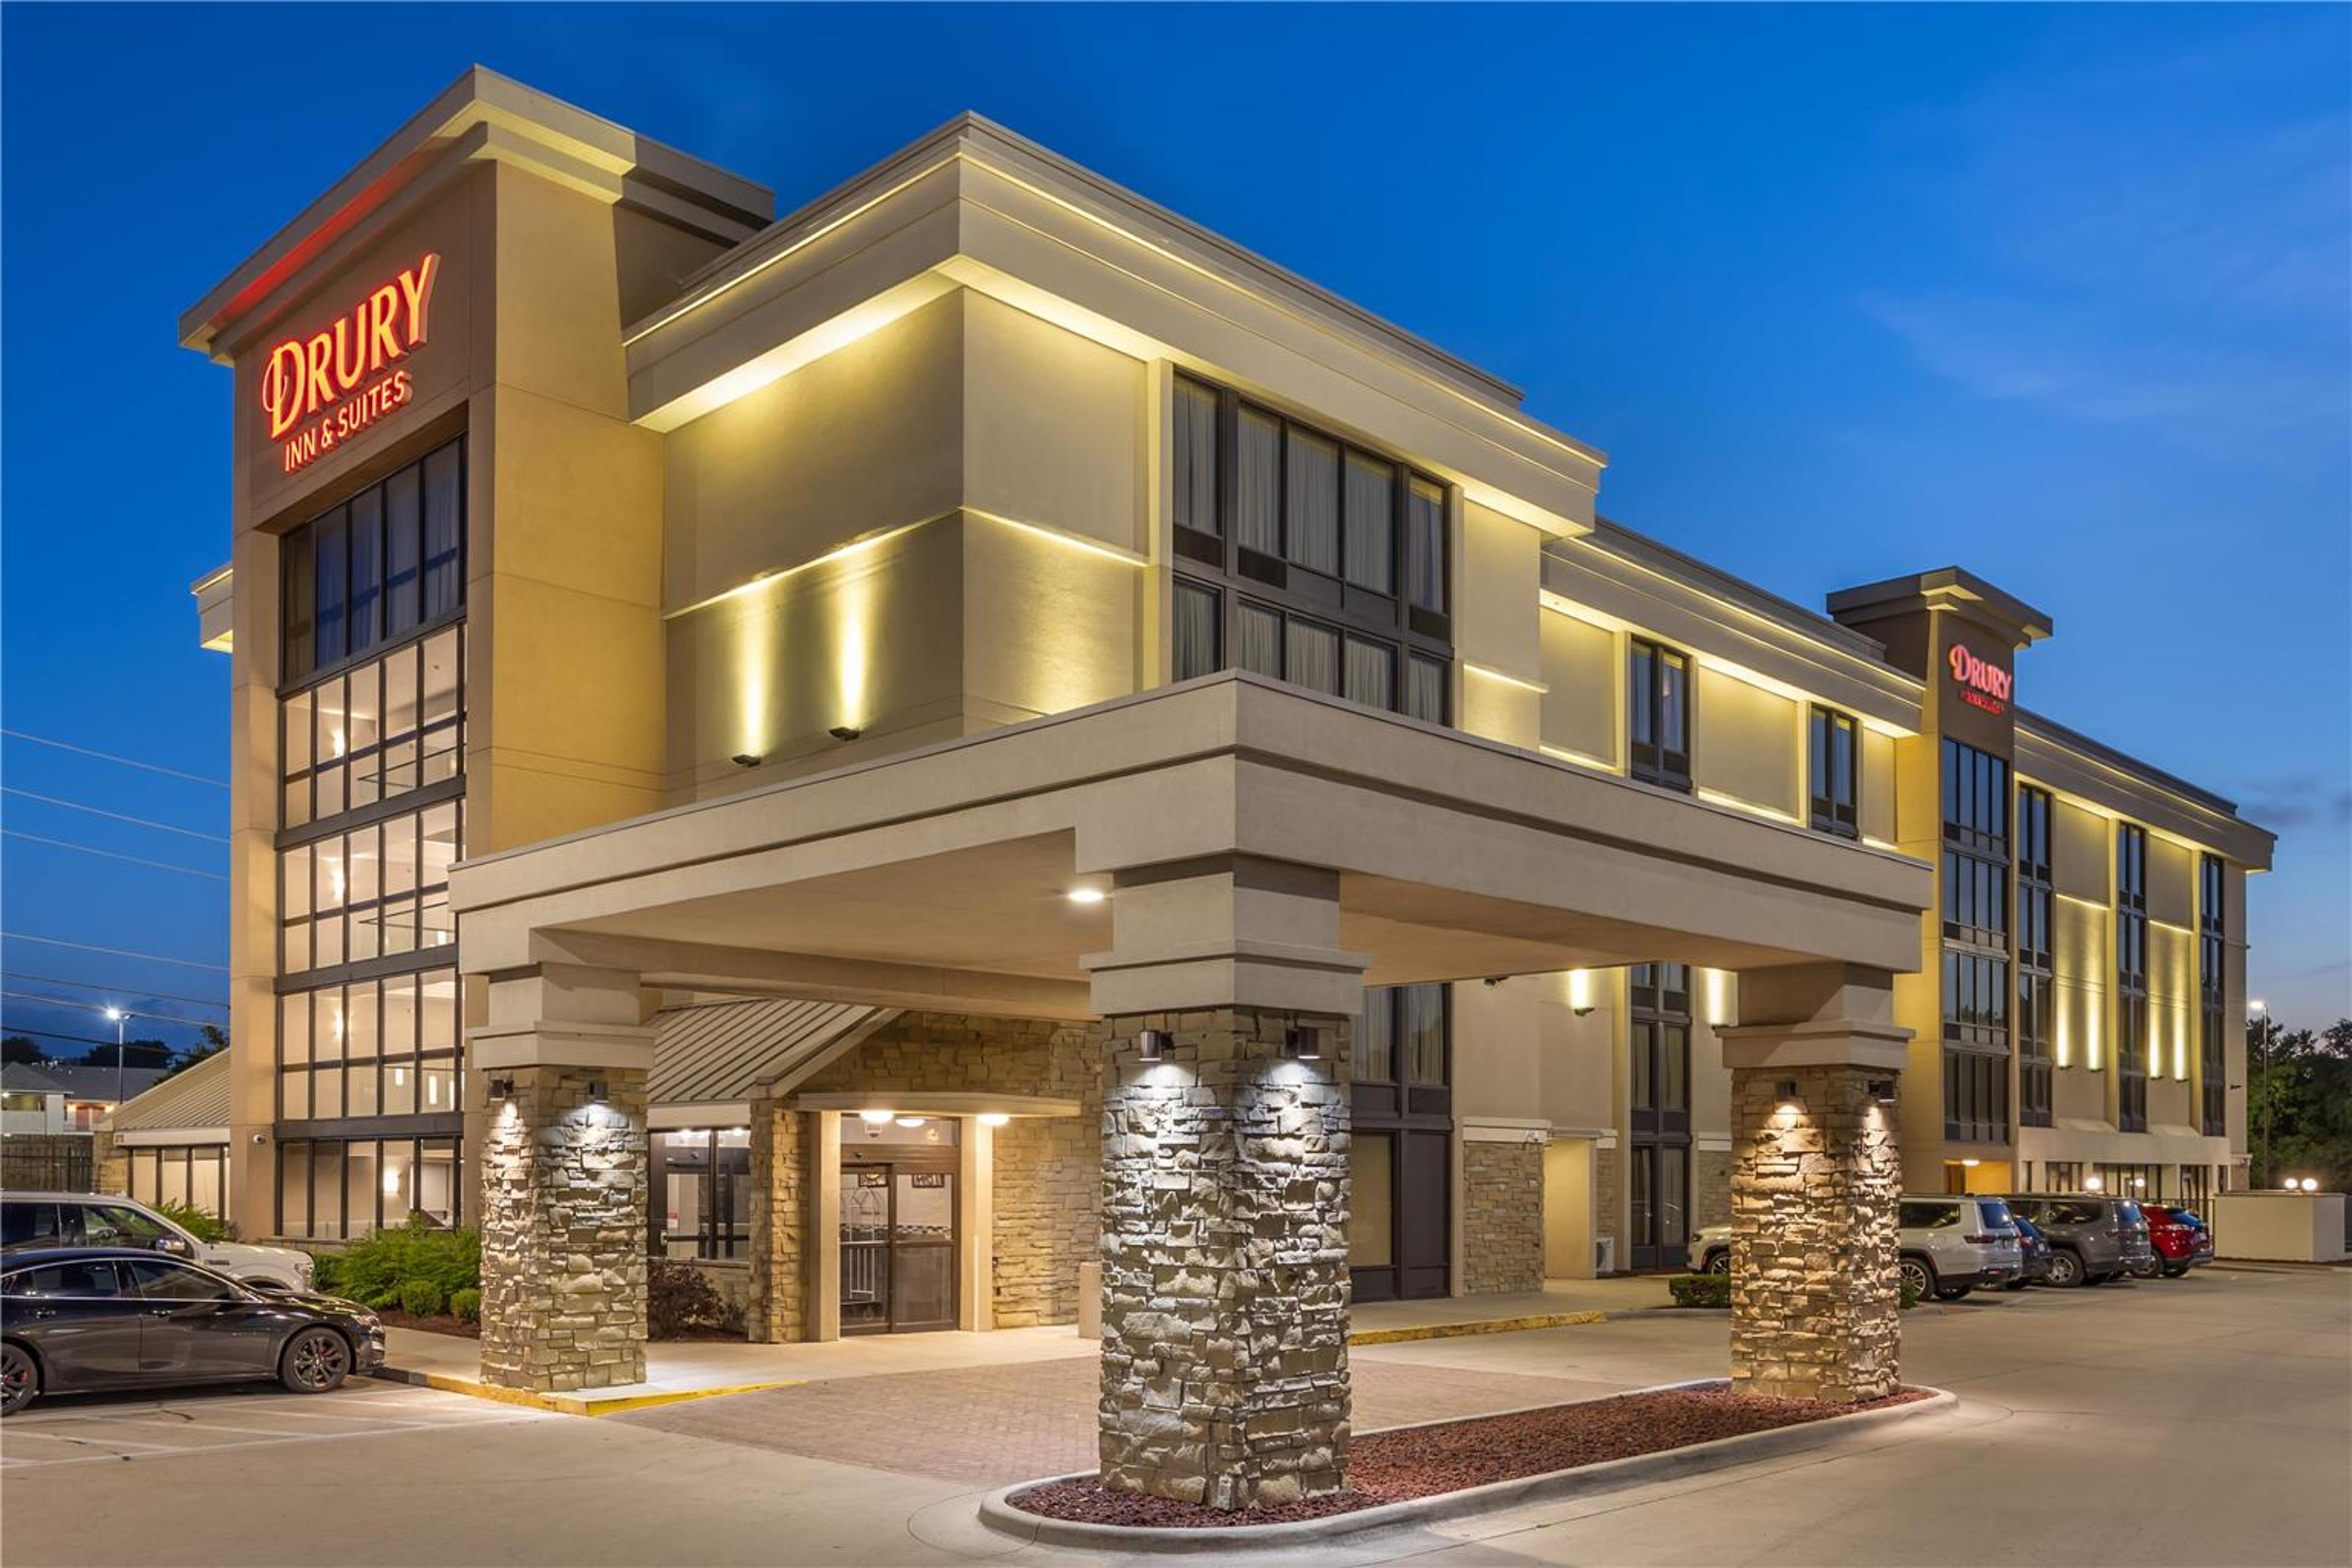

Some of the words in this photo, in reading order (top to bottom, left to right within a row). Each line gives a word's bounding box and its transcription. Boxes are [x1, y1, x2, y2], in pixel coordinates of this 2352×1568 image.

[263, 253, 440, 439] DRURY
[285, 429, 316, 472] INN
[321, 418, 333, 448] &
[338, 371, 412, 437] SUITES
[1949, 644, 2011, 699] DRURY
